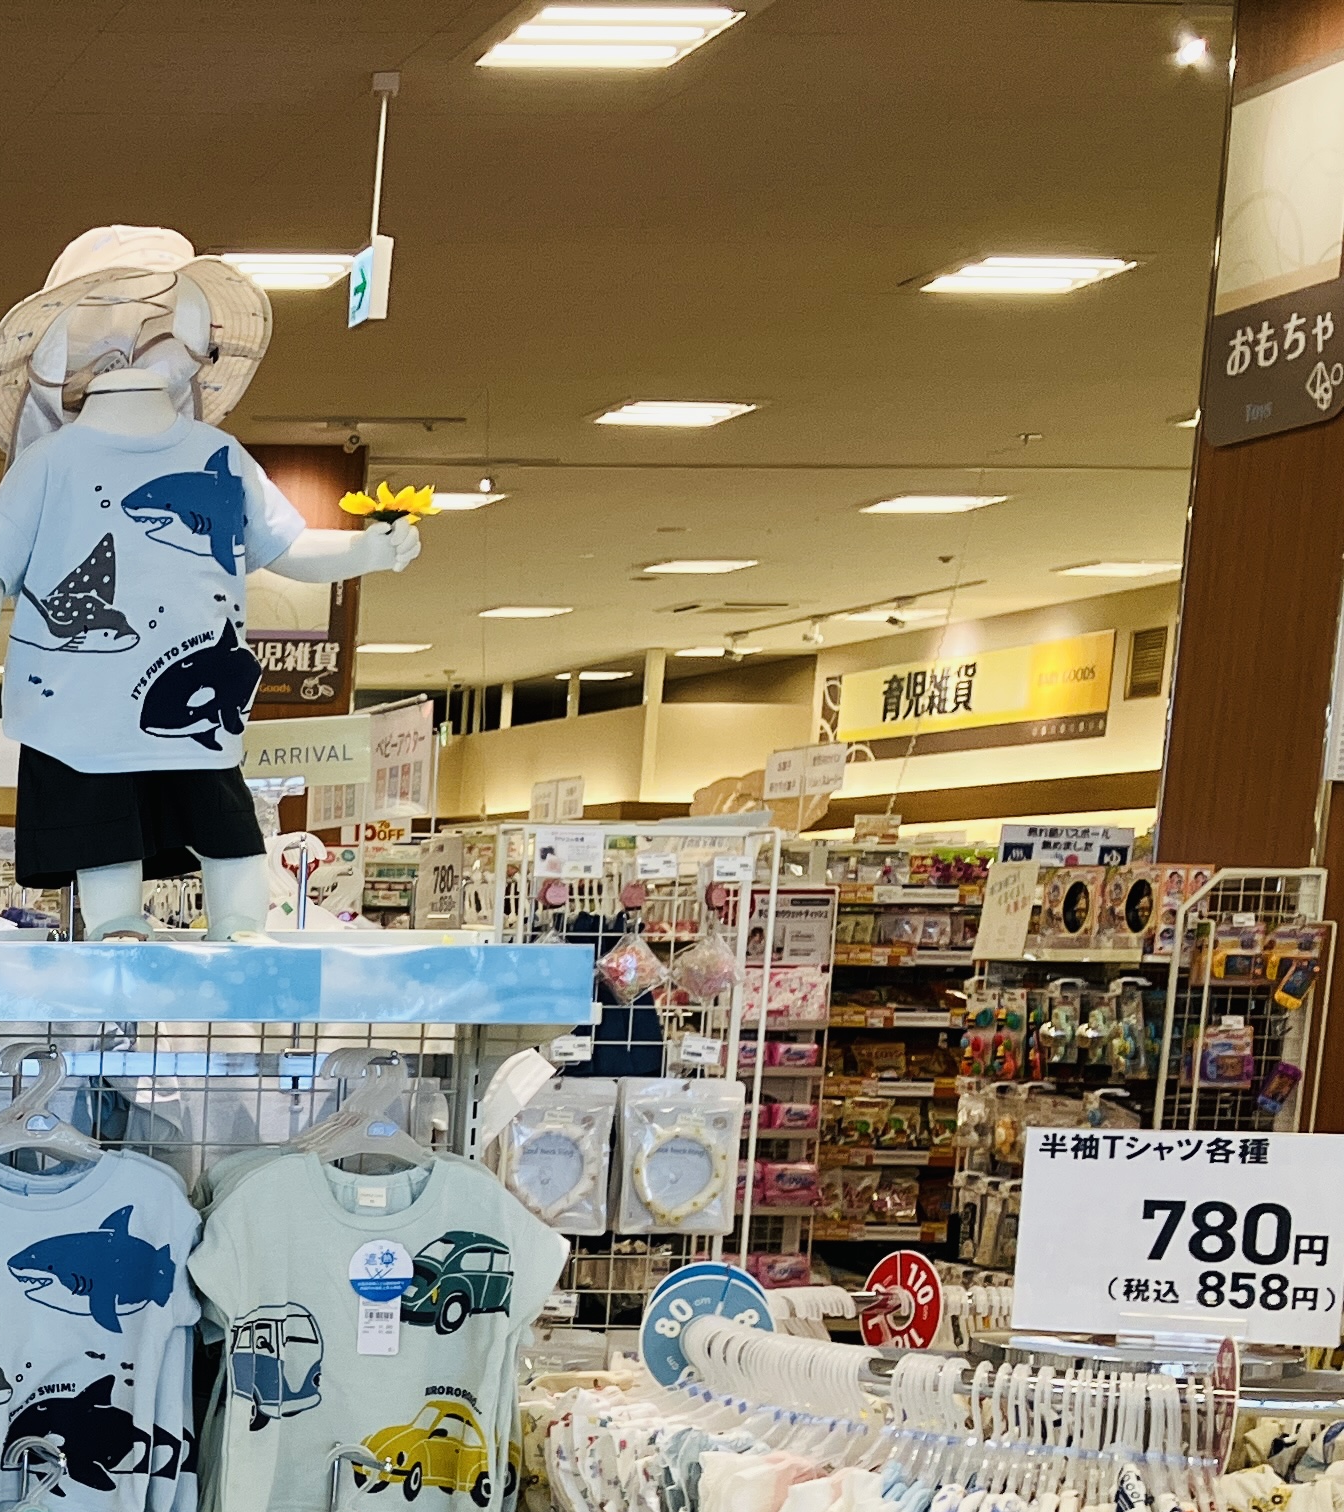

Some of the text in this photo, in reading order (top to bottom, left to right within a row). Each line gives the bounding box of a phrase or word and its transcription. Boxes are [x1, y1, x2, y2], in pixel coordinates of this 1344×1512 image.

[1226, 311, 1334, 376] おもちゃ
[131, 630, 215, 700] IT'S FUN TO SWIM!
[257, 642, 340, 671] 児雑貨
[882, 662, 976, 722] 育児雑貨
[258, 744, 353, 767] ARRIVAL
[1039, 1132, 1270, 1165] 半袖Tシャツ各種
[1142, 1199, 1329, 1266] 780円
[909, 1263, 934, 1305] 110
[655, 1298, 693, 1339] 80
[37, 1382, 76, 1396] SWIM!
